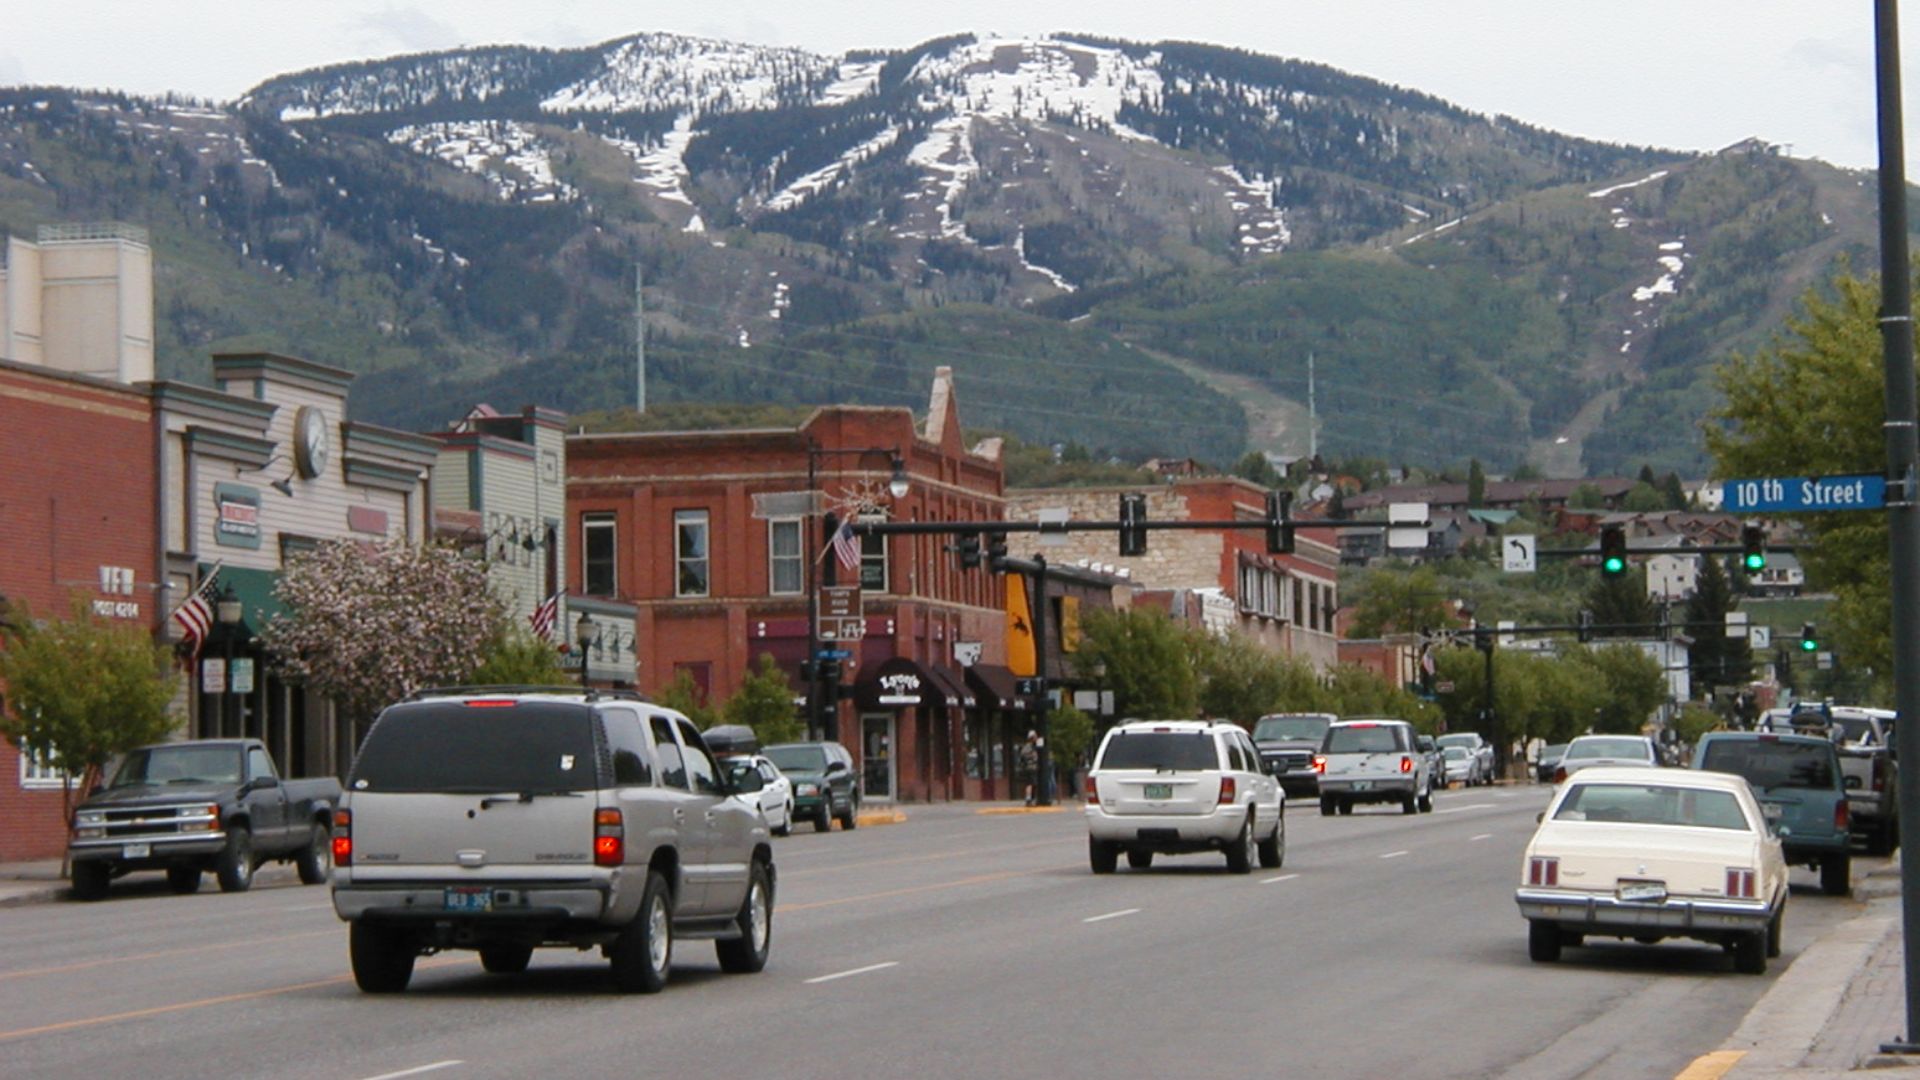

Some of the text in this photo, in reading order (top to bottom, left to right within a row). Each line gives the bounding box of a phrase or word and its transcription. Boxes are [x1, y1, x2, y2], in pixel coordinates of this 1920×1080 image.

[1737, 479, 1865, 507] 10th Street
[99, 566, 135, 595] VFW
[93, 600, 115, 616] POST
